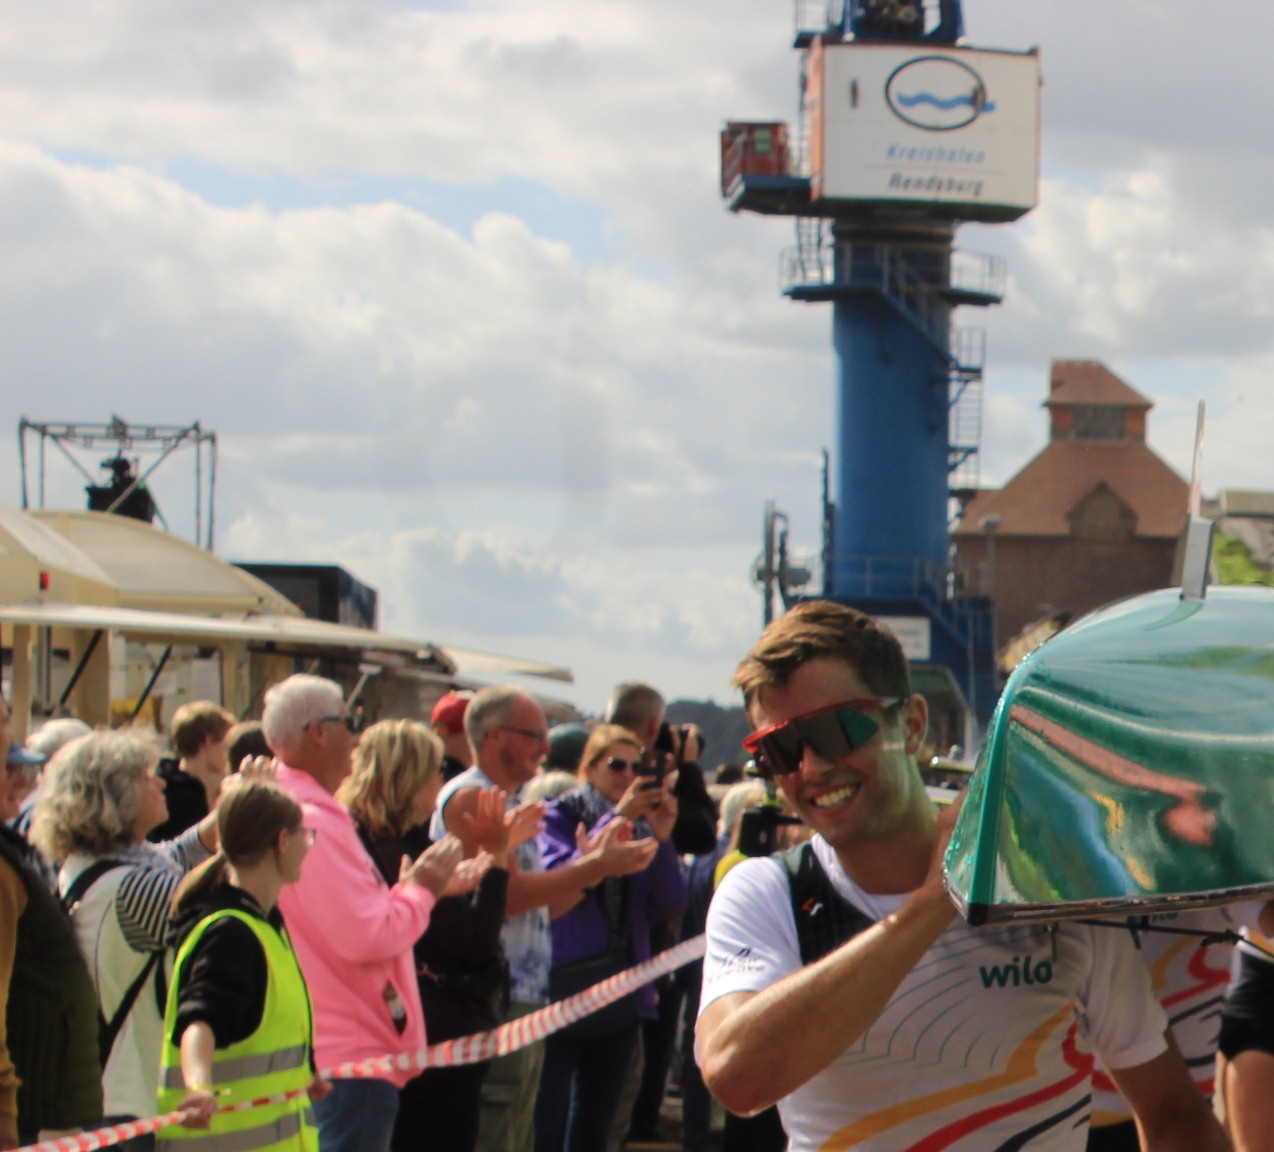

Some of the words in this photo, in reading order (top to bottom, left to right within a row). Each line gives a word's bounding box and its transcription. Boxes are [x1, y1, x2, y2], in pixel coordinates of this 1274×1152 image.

[886, 143, 985, 163] Kreishafen
[889, 172, 984, 196] Rendsburg
[979, 956, 1053, 988] wilo
